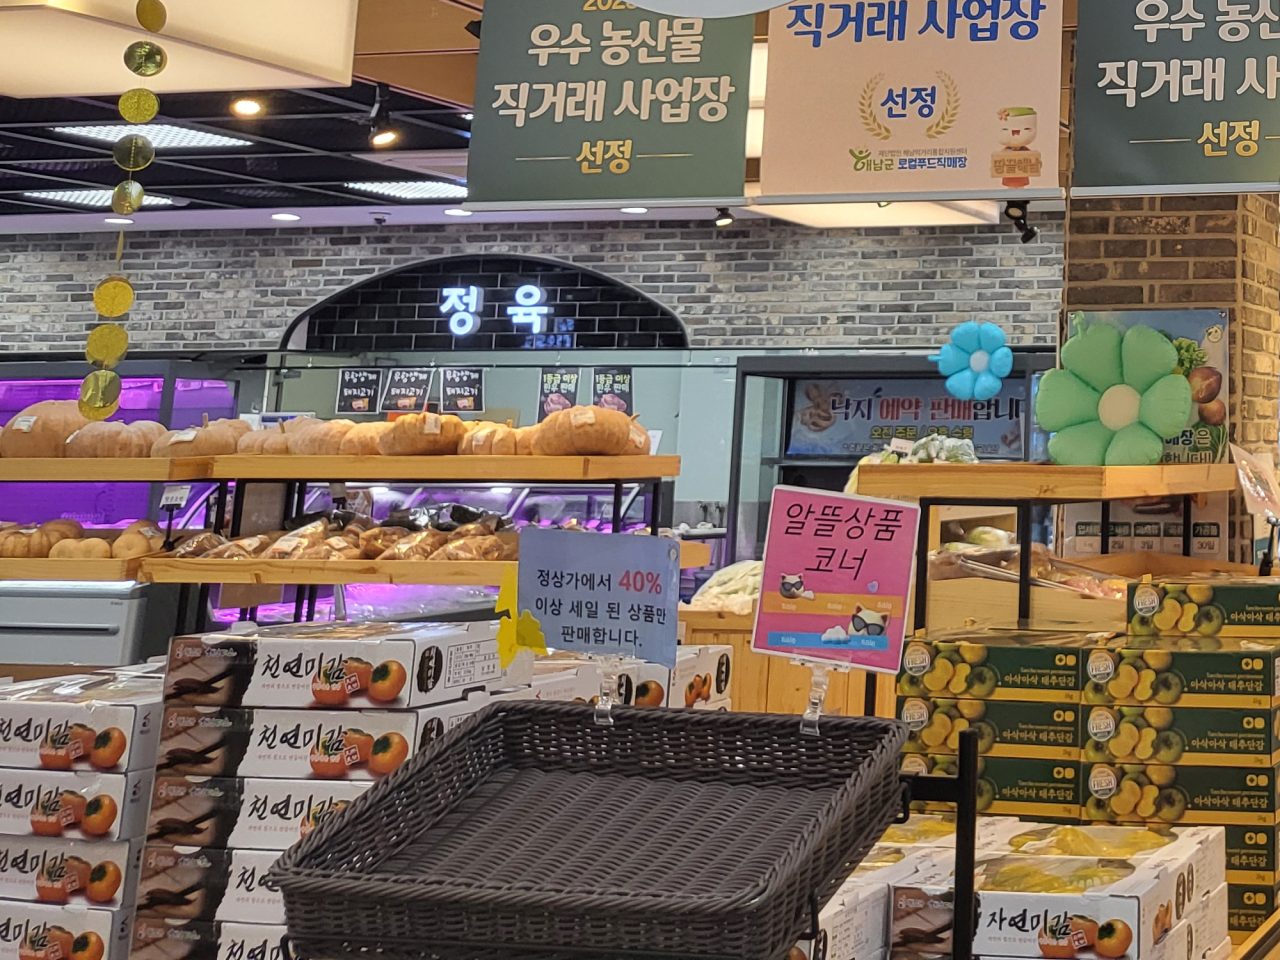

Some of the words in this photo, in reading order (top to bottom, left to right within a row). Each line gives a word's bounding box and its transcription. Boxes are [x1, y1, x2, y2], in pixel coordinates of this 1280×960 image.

[786, 0, 908, 48] 직거래
[528, 23, 591, 66] 우수
[600, 18, 704, 65] 농산물
[1097, 57, 1226, 108] 직거래
[491, 80, 607, 127] 직거래
[613, 76, 735, 123] 사업장
[880, 85, 937, 119] 선정
[1197, 120, 1260, 157] 선정
[575, 139, 632, 174] 선정
[879, 397, 921, 420] 예약
[895, 426, 918, 439] 주문
[785, 502, 903, 542] 알뜰상품
[805, 547, 868, 581] 코너
[536, 568, 612, 593] 정상가에서
[618, 569, 662, 595] 40%
[535, 597, 562, 617] 이상
[569, 601, 598, 620] 세일
[606, 602, 622, 621] 된
[627, 604, 667, 624] 상품만
[560, 625, 642, 648] 판매합니다.
